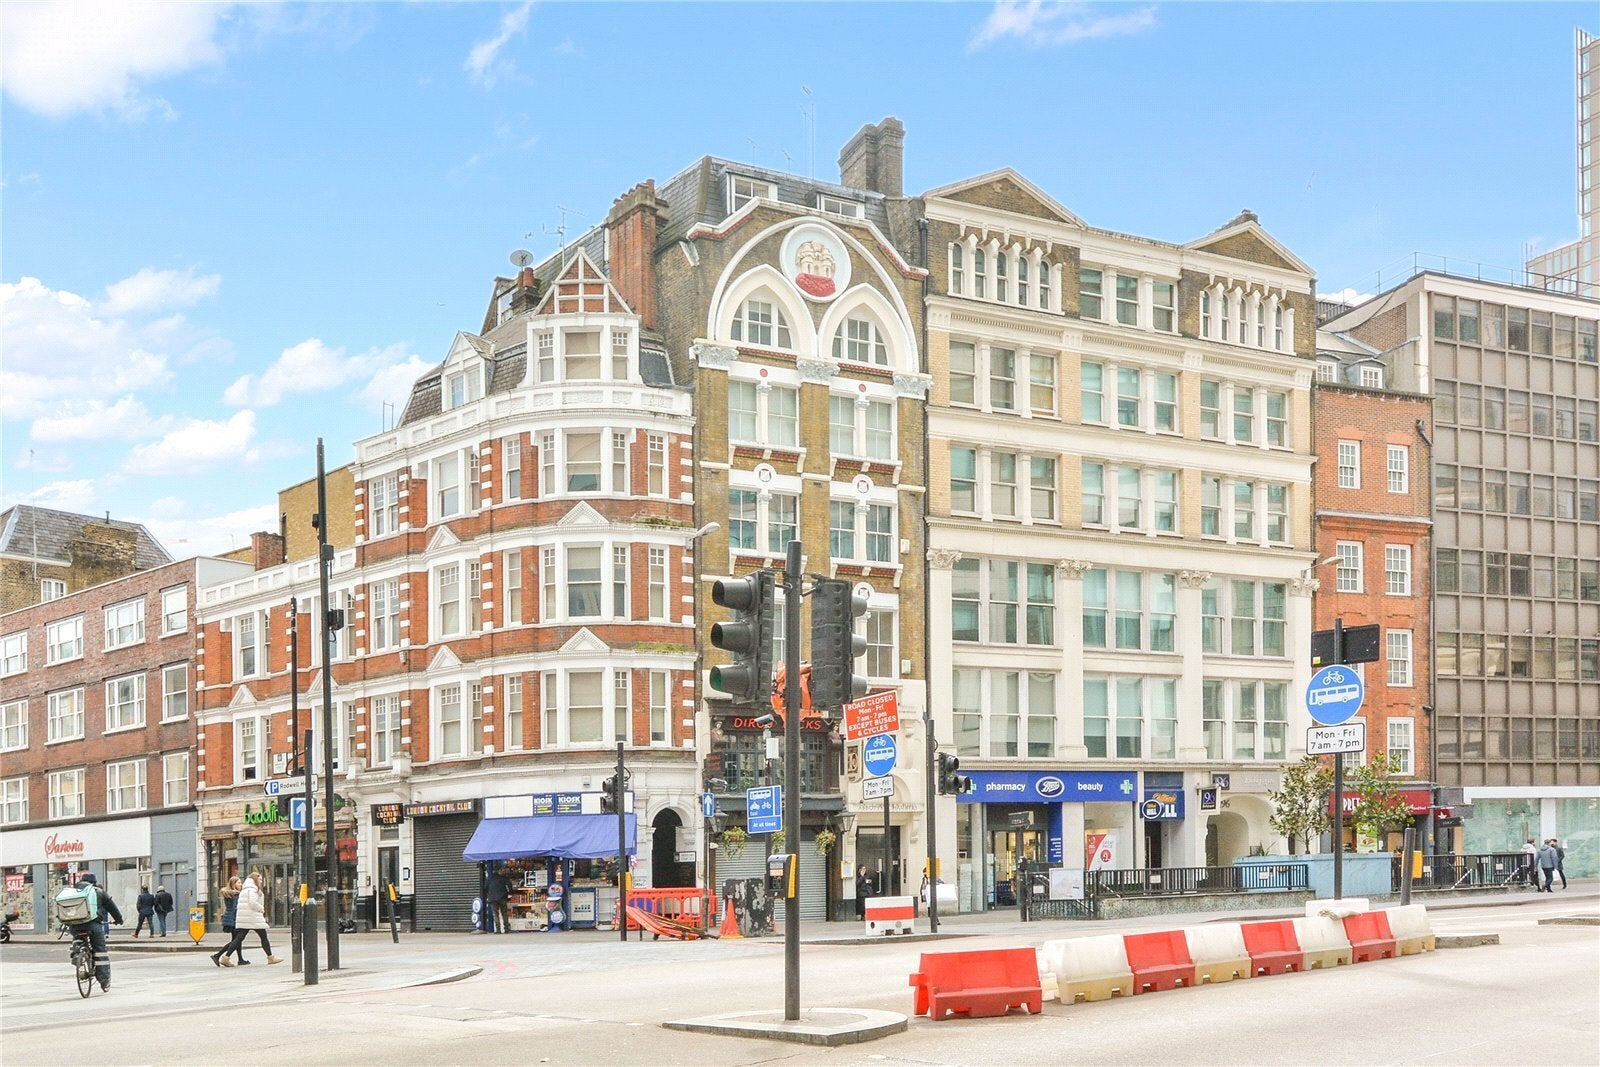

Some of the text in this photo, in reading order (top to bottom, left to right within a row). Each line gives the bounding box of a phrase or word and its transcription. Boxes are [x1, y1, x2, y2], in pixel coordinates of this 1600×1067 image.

[847, 695, 893, 710] ROAD CLOSED
[848, 715, 897, 731] EXCEPT BUSES
[863, 724, 888, 735] CYCLES
[1315, 731, 1335, 739] Mon
[1343, 729, 1355, 737] Fri
[280, 781, 299, 789] Rodwell
[985, 783, 1026, 792] pharmacy
[1077, 782, 1104, 792] beauty
[457, 801, 471, 811] CLUB
[534, 797, 553, 805] KIOSK
[44, 832, 84, 858] Sartoria
[6, 880, 24, 891] SALE
